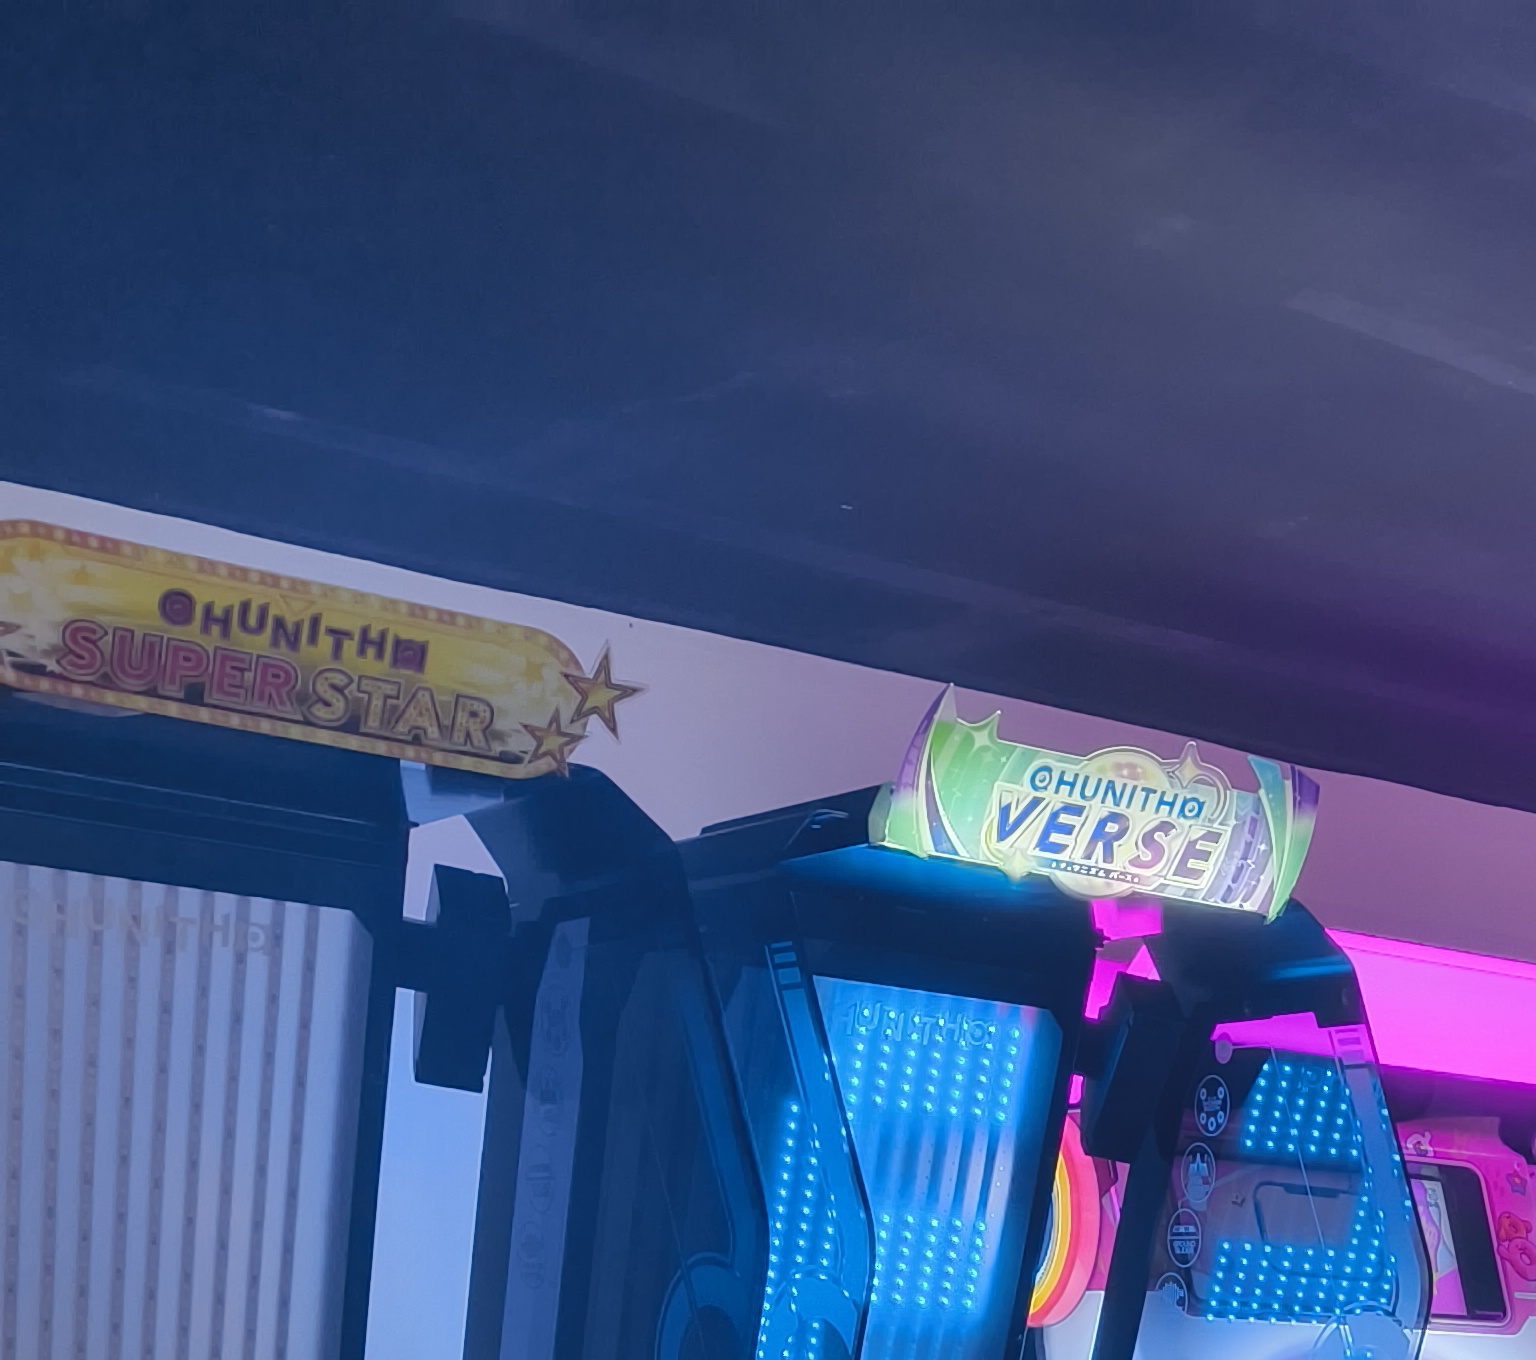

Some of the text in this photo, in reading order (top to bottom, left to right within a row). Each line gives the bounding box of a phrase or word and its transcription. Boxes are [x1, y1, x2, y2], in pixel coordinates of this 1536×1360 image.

[56, 618, 496, 752] SUPER STAR
[997, 788, 1227, 882] VERSE
